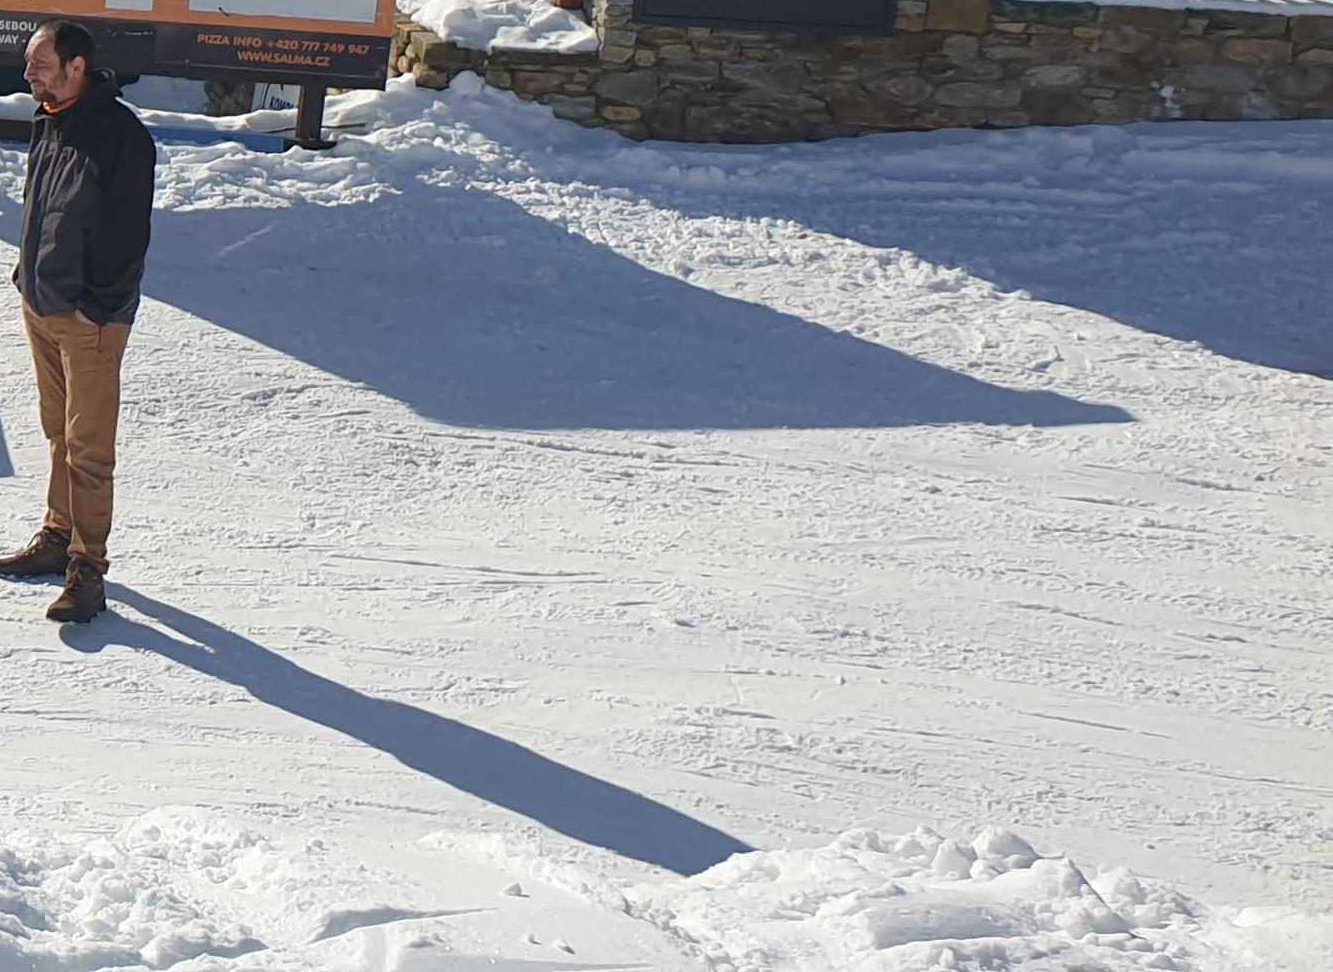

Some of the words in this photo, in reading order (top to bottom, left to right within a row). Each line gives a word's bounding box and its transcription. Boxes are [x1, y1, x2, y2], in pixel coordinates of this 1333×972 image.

[197, 34, 230, 46] PIZZA
[233, 36, 262, 48] INFO
[267, 38, 298, 50] +420
[301, 40, 320, 51] 777
[323, 42, 344, 53] 749
[348, 44, 369, 55] 947
[237, 50, 331, 67] WWW.SALMA.CZ
